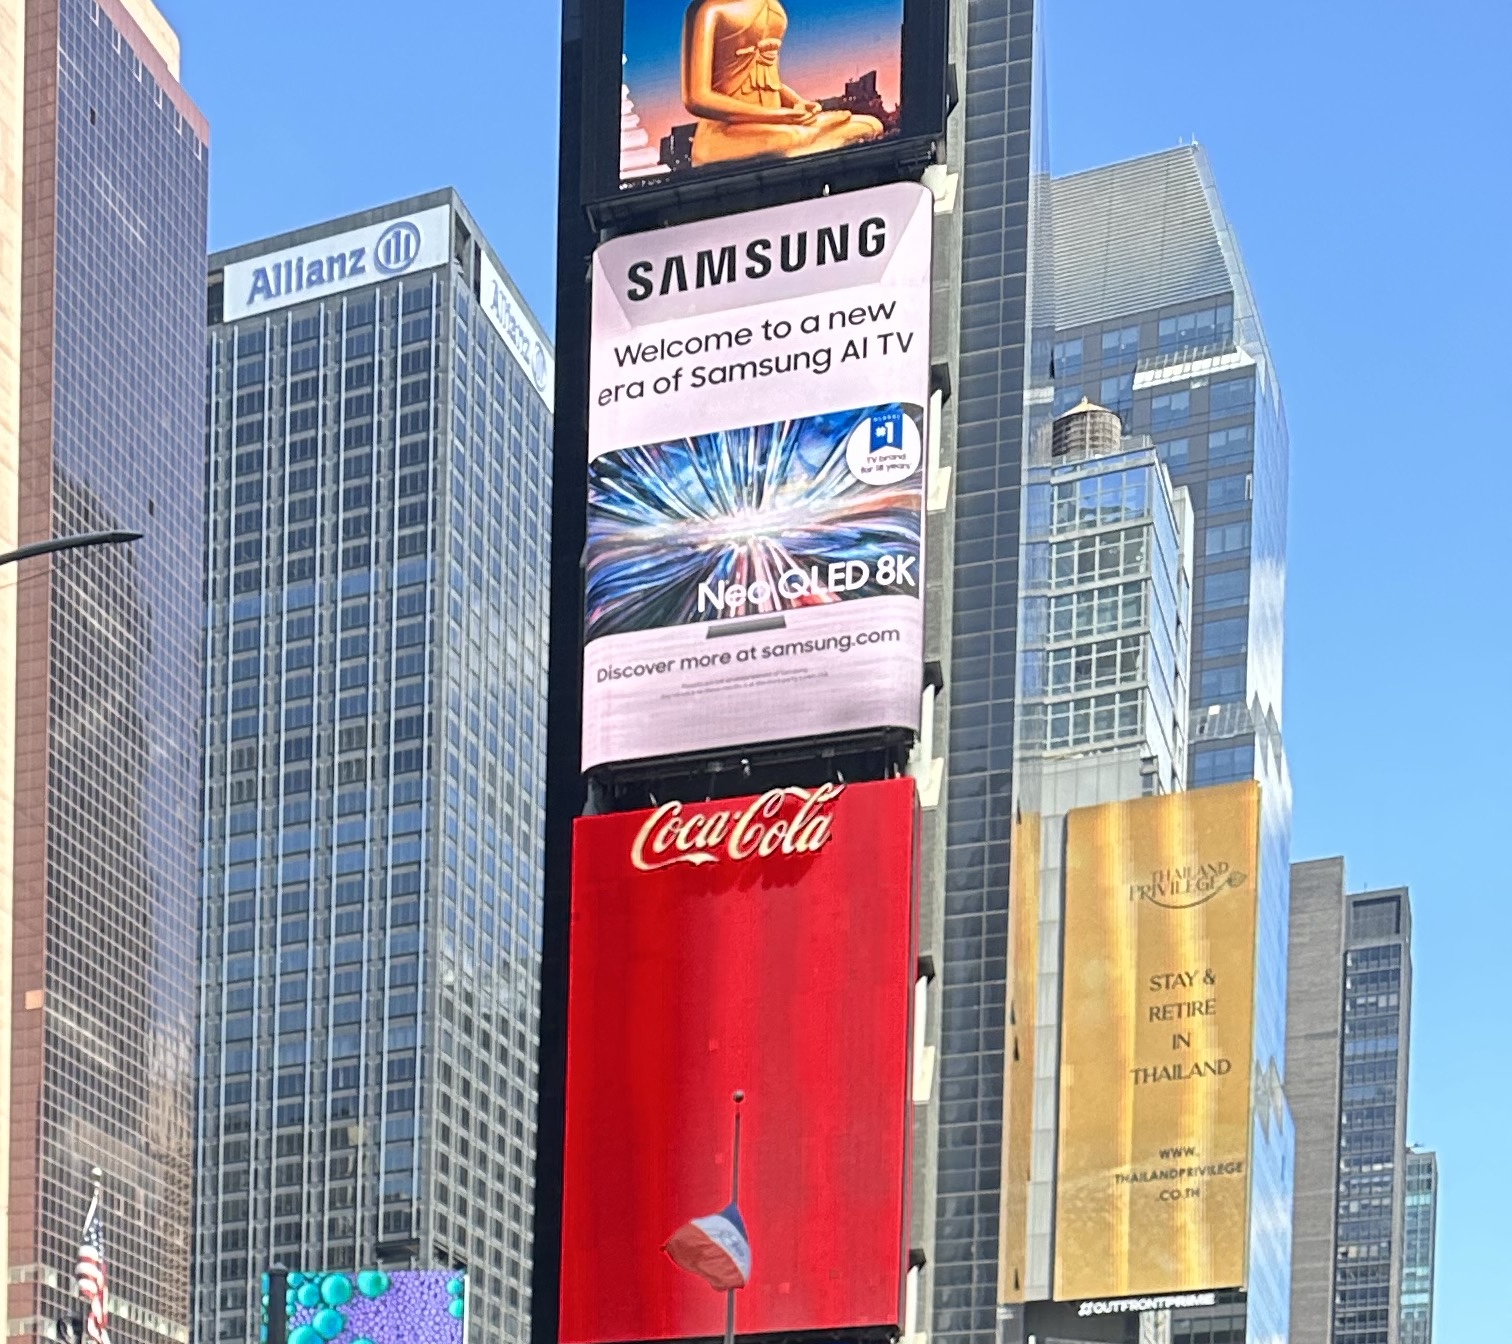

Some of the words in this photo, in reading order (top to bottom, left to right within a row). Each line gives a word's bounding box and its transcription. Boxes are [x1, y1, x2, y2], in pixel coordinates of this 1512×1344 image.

[246, 246, 367, 305] Allianz
[626, 216, 887, 302] SAMSUNG
[490, 279, 532, 365] Allianz
[614, 327, 753, 368] Welcome
[761, 317, 792, 342] to
[800, 313, 821, 334] a
[829, 300, 897, 330] new
[597, 378, 645, 408] era
[653, 369, 684, 393] of
[690, 346, 832, 388] Samsung
[841, 337, 868, 363] AI
[877, 331, 915, 356] TV
[875, 421, 894, 444] #1
[879, 453, 906, 462] brand
[697, 580, 771, 614] Neo
[778, 559, 871, 601] QLED
[875, 554, 916, 587] 8K
[596, 656, 677, 684] Discover
[680, 651, 732, 671] more
[738, 645, 758, 662] at
[761, 626, 901, 660] samsung.com
[630, 782, 846, 872] Coca-Cola
[1152, 861, 1230, 883] THAILAND
[1149, 969, 1199, 992] STAY
[1202, 967, 1217, 986] &
[1149, 998, 1217, 1022] RETIRE
[1172, 1032, 1192, 1050] IN
[1130, 1058, 1232, 1085] THAILAND
[1114, 1160, 1244, 1185] THAILANDPRIVILEGE
